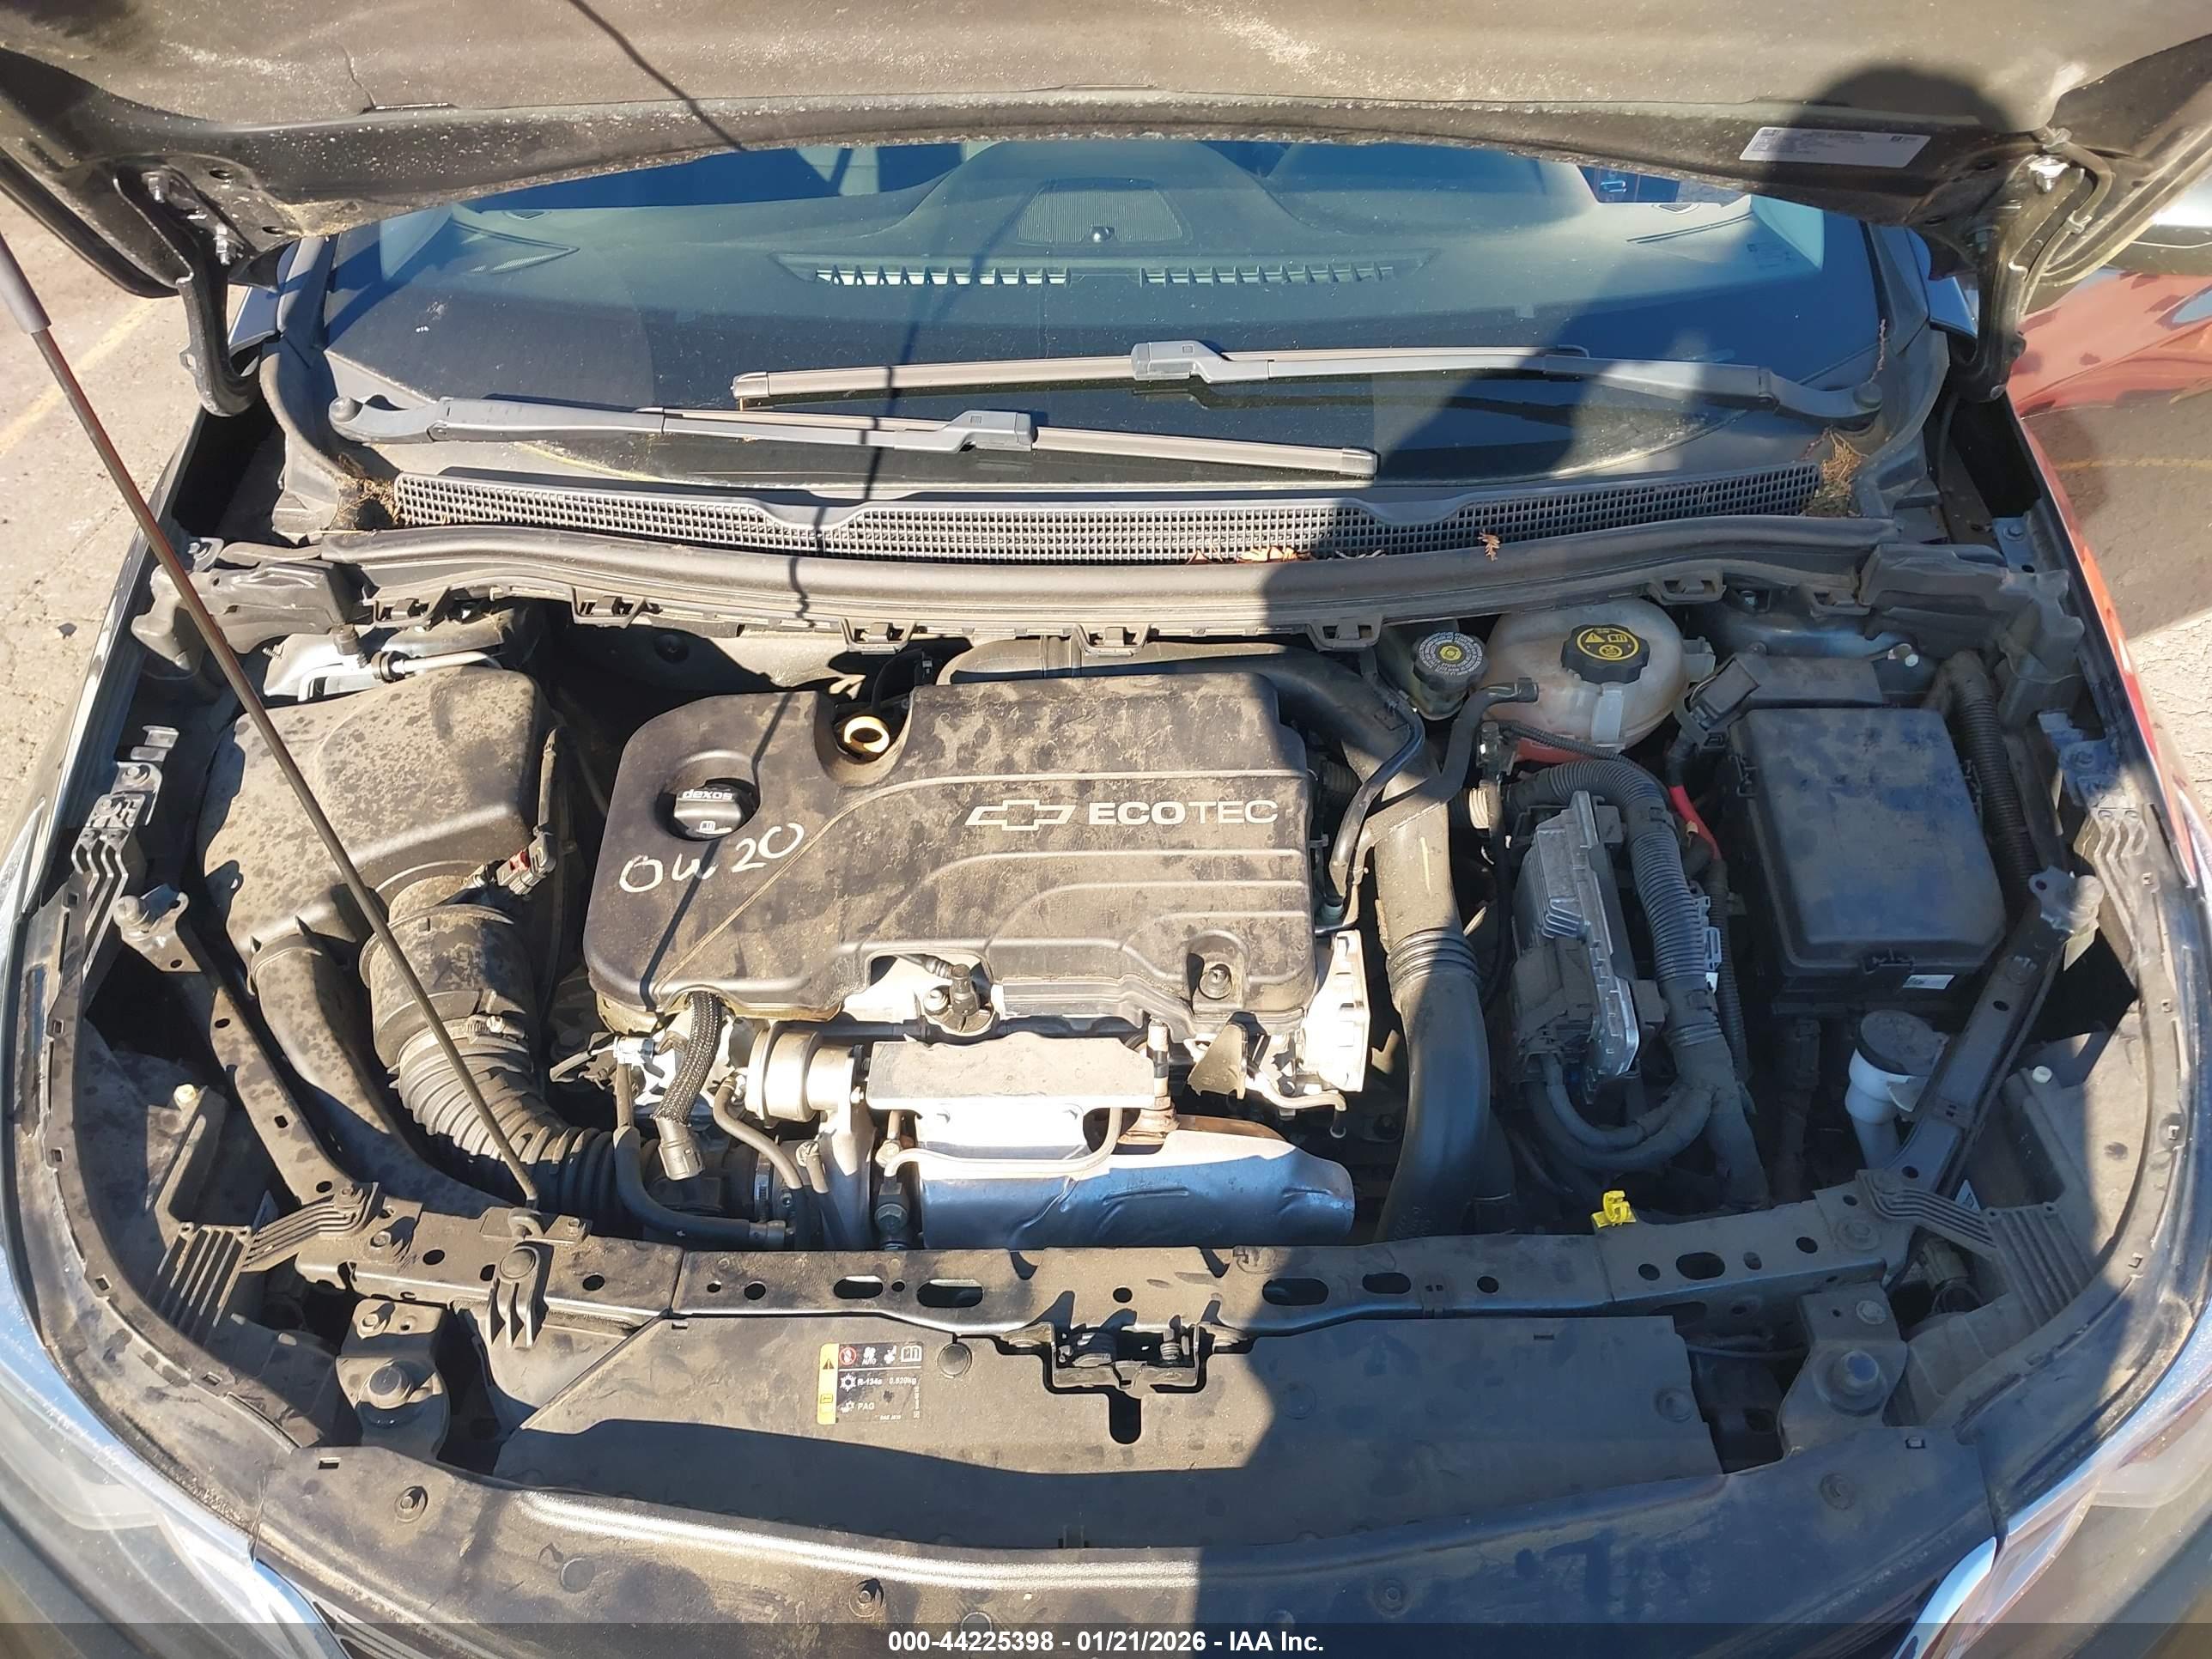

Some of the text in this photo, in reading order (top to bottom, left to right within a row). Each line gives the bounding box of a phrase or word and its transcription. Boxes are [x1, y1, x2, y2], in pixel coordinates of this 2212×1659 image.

[683, 788, 733, 799] dexos
[1088, 800, 1279, 825] ECOTEC
[732, 822, 805, 873] 20
